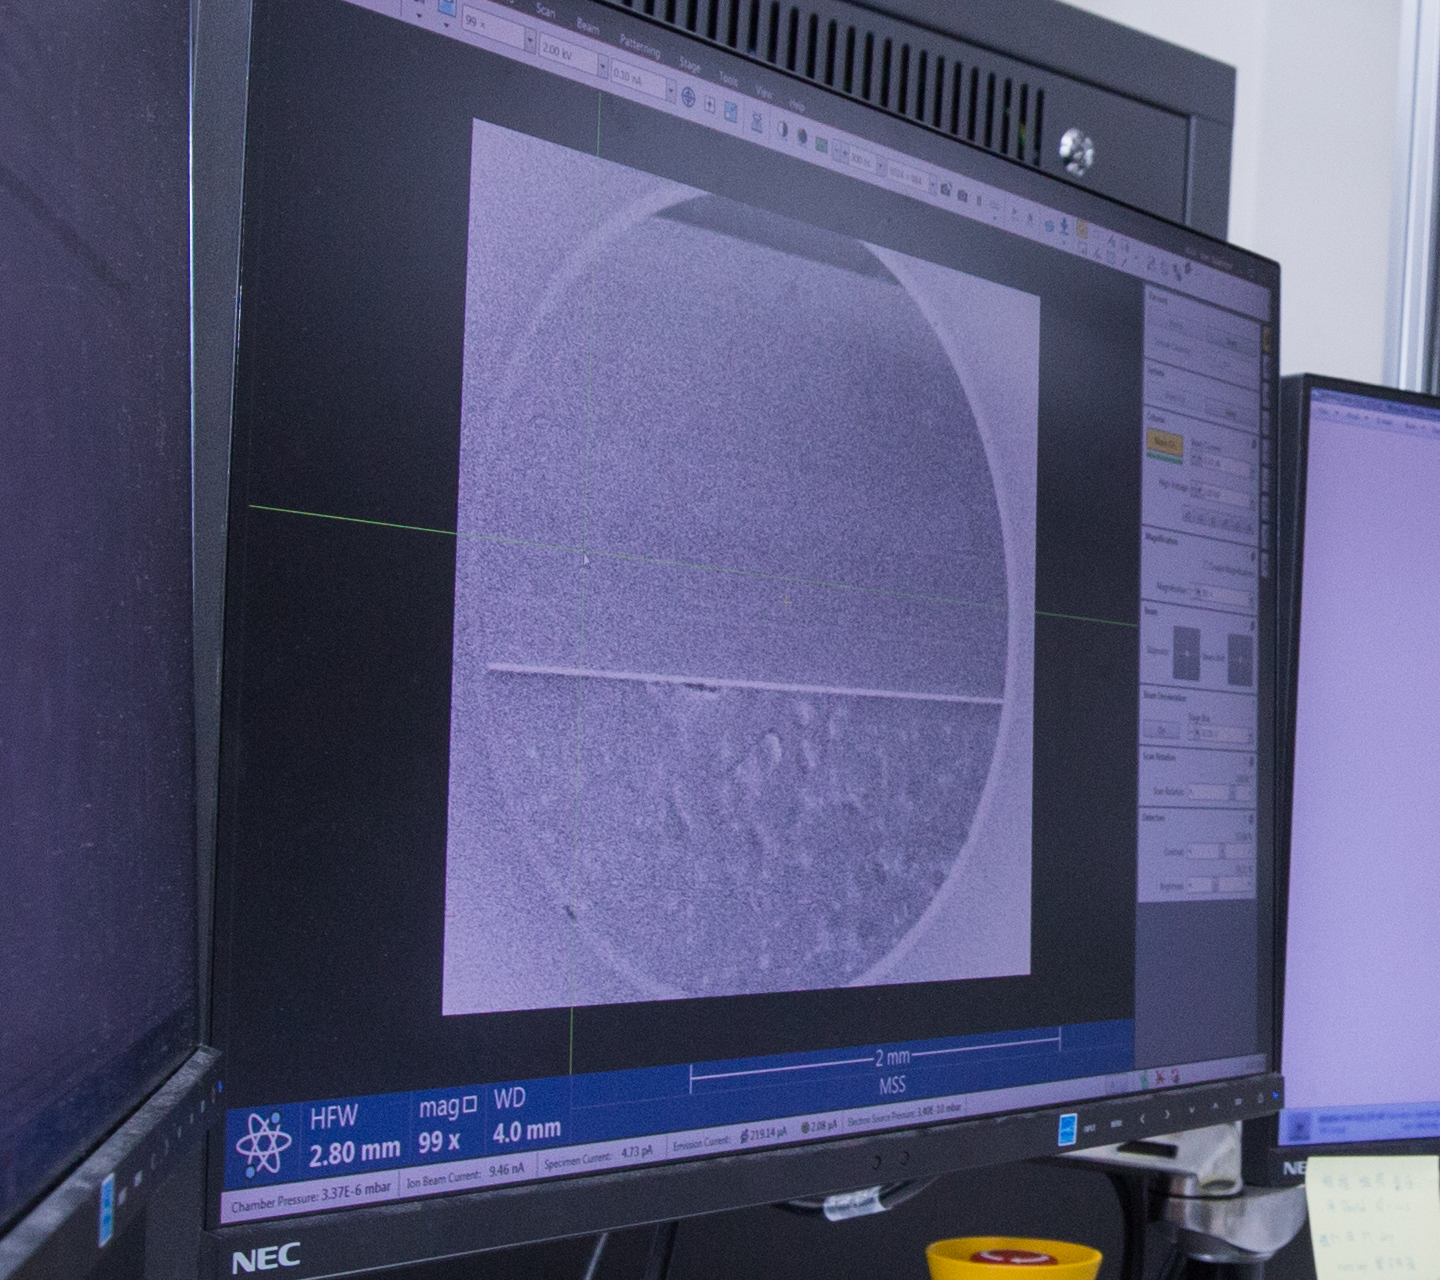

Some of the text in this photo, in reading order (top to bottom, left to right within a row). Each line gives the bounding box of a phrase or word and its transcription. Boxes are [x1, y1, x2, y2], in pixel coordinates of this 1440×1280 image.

[536, 2, 556, 19] Scan
[577, 18, 600, 35] Beam
[620, 33, 661, 60] Patterning
[679, 55, 701, 75] Stage
[875, 1049, 911, 1067] 2 mm
[880, 1076, 906, 1095] MSS
[310, 1087, 526, 1130] HFW mag WD
[310, 1120, 561, 1168] 2.80 mm 99 x 4.0 mm
[544, 1156, 581, 1172] Specimen
[582, 1152, 613, 1165] Current:
[621, 1145, 639, 1158] 4.73
[407, 1162, 525, 1190] Ion Beam Current: 9.46 nA
[1283, 1160, 1308, 1176] NE
[231, 1180, 392, 1214] Chamber Pressure: 3.37E-6 mbar
[232, 1242, 301, 1275] NEC
